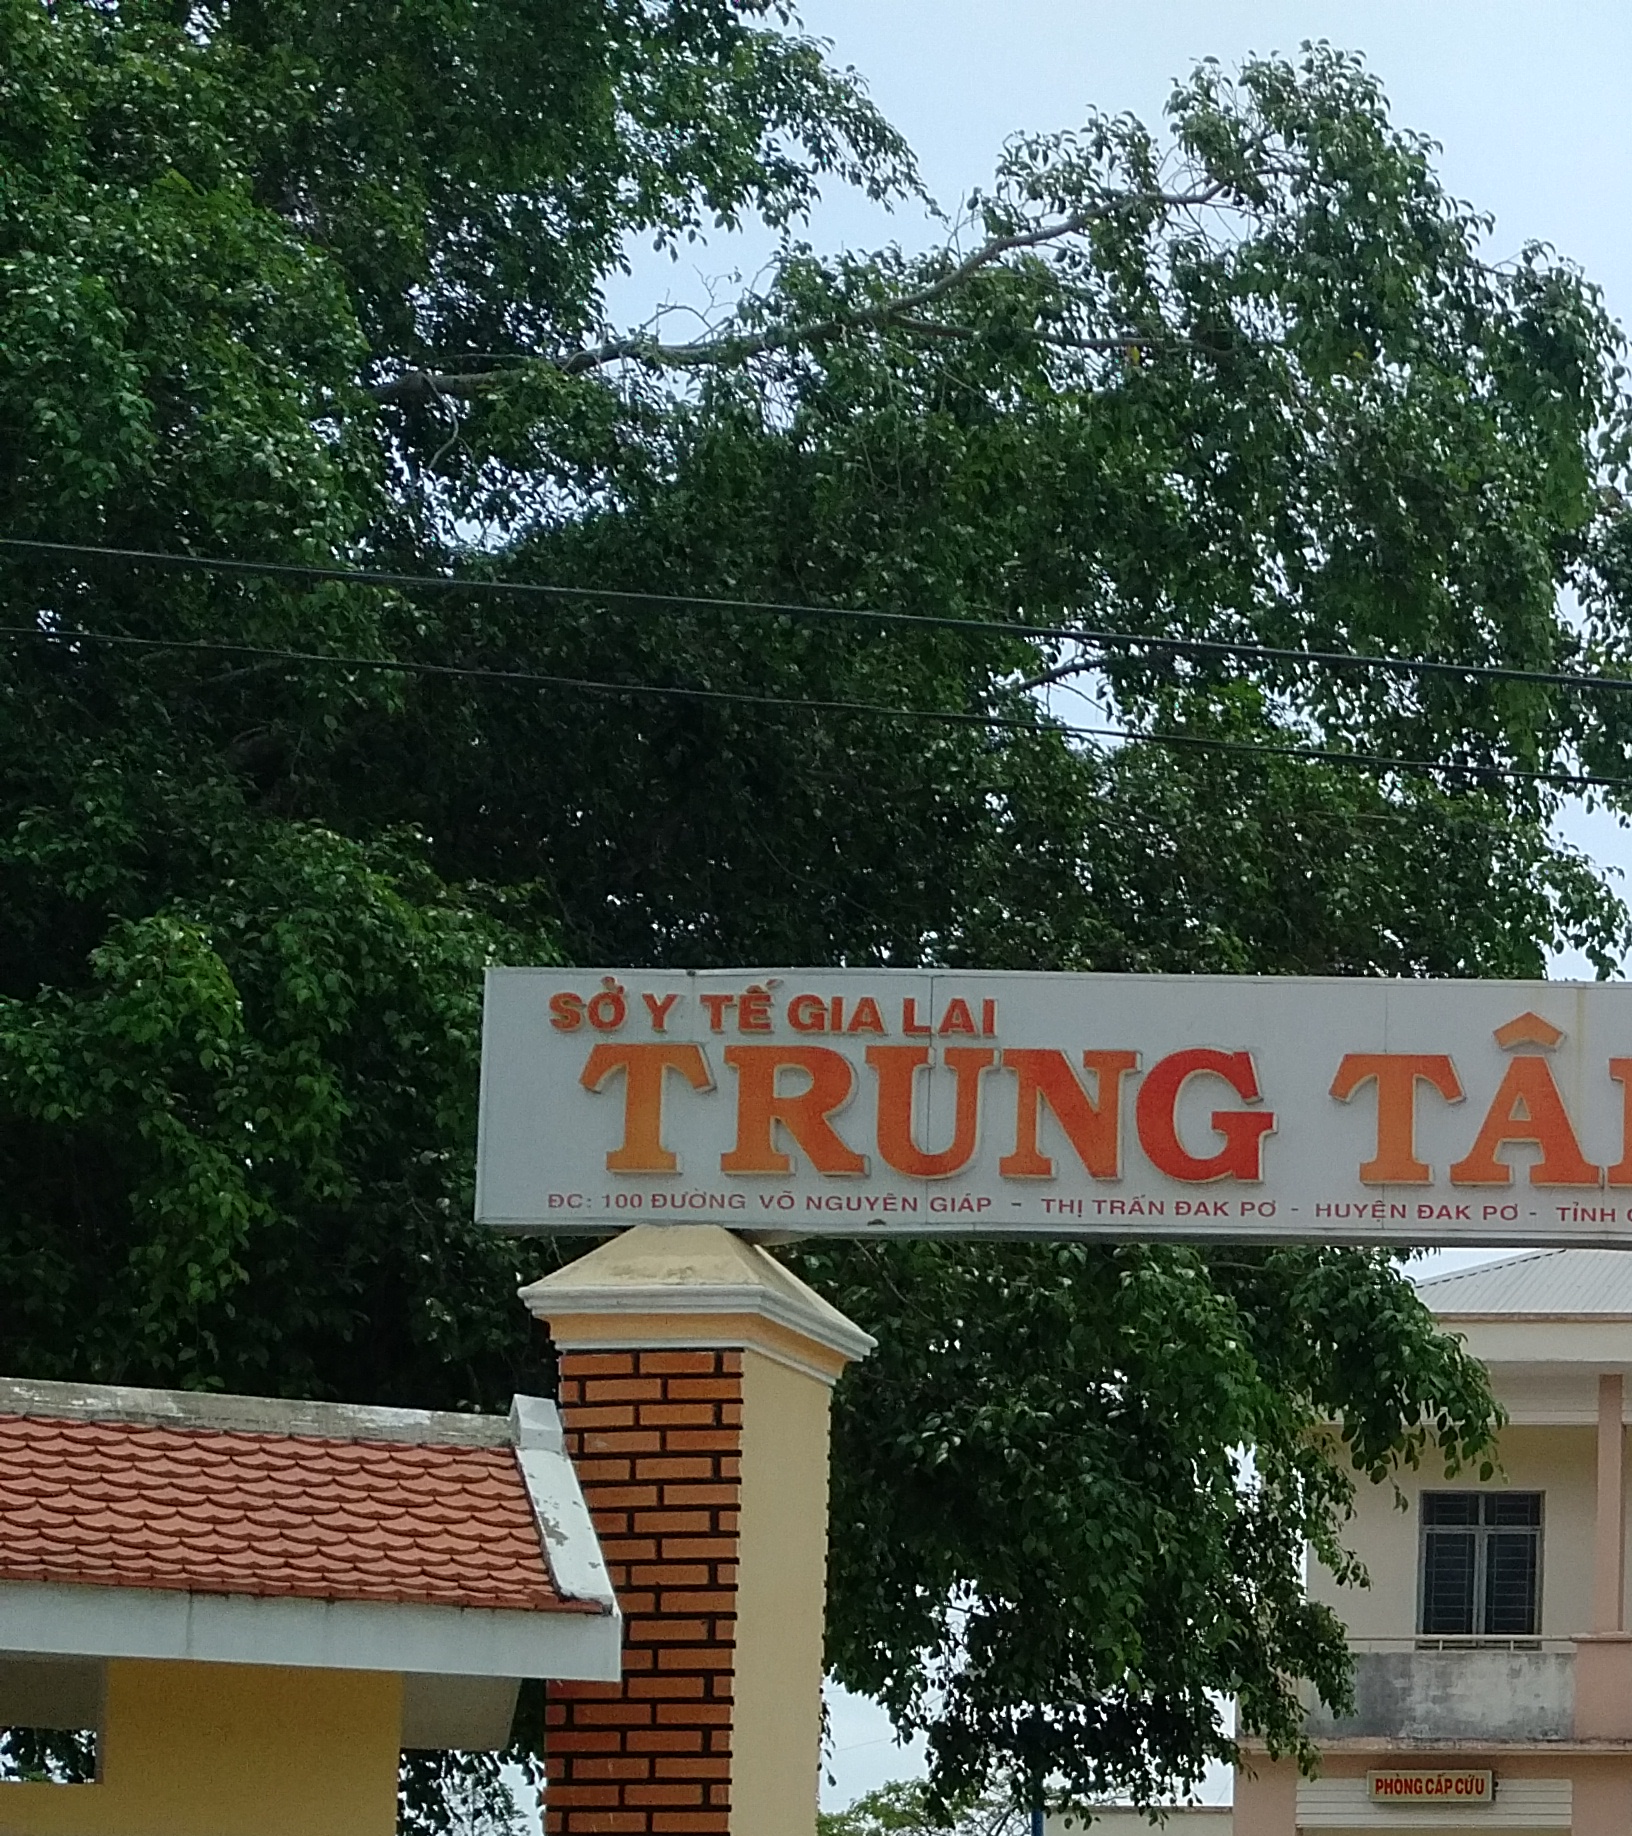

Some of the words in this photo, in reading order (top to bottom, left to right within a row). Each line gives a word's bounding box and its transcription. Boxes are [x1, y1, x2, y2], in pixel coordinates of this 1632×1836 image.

[549, 976, 626, 1033] SỞ
[642, 993, 680, 1034] Y
[701, 978, 784, 1035] TẾ
[787, 994, 887, 1036] GIA
[902, 997, 998, 1037] LAI
[578, 1041, 1278, 1185] TRUNG
[548, 1193, 591, 1210] ĐC:
[603, 1193, 643, 1210] 100
[650, 1188, 746, 1210] ĐƯỜNG
[759, 1190, 796, 1211] VÕ
[806, 1191, 918, 1213] NGUYÊN
[929, 1190, 992, 1214] GIÁP
[1041, 1198, 1083, 1219] THỊ
[1092, 1194, 1164, 1217] TRẤN
[1174, 1199, 1228, 1218] ĐAK
[1240, 1199, 1277, 1218] PƠ
[1315, 1200, 1407, 1223] HUYỆN
[1417, 1204, 1471, 1221] ĐAK
[1482, 1203, 1519, 1222] PƠ
[1556, 1201, 1616, 1224] TỈNH
[1375, 1773, 1423, 1796] PHÒNG
[1425, 1772, 1453, 1796] CẤP
[1455, 1774, 1485, 1796] CỨU
